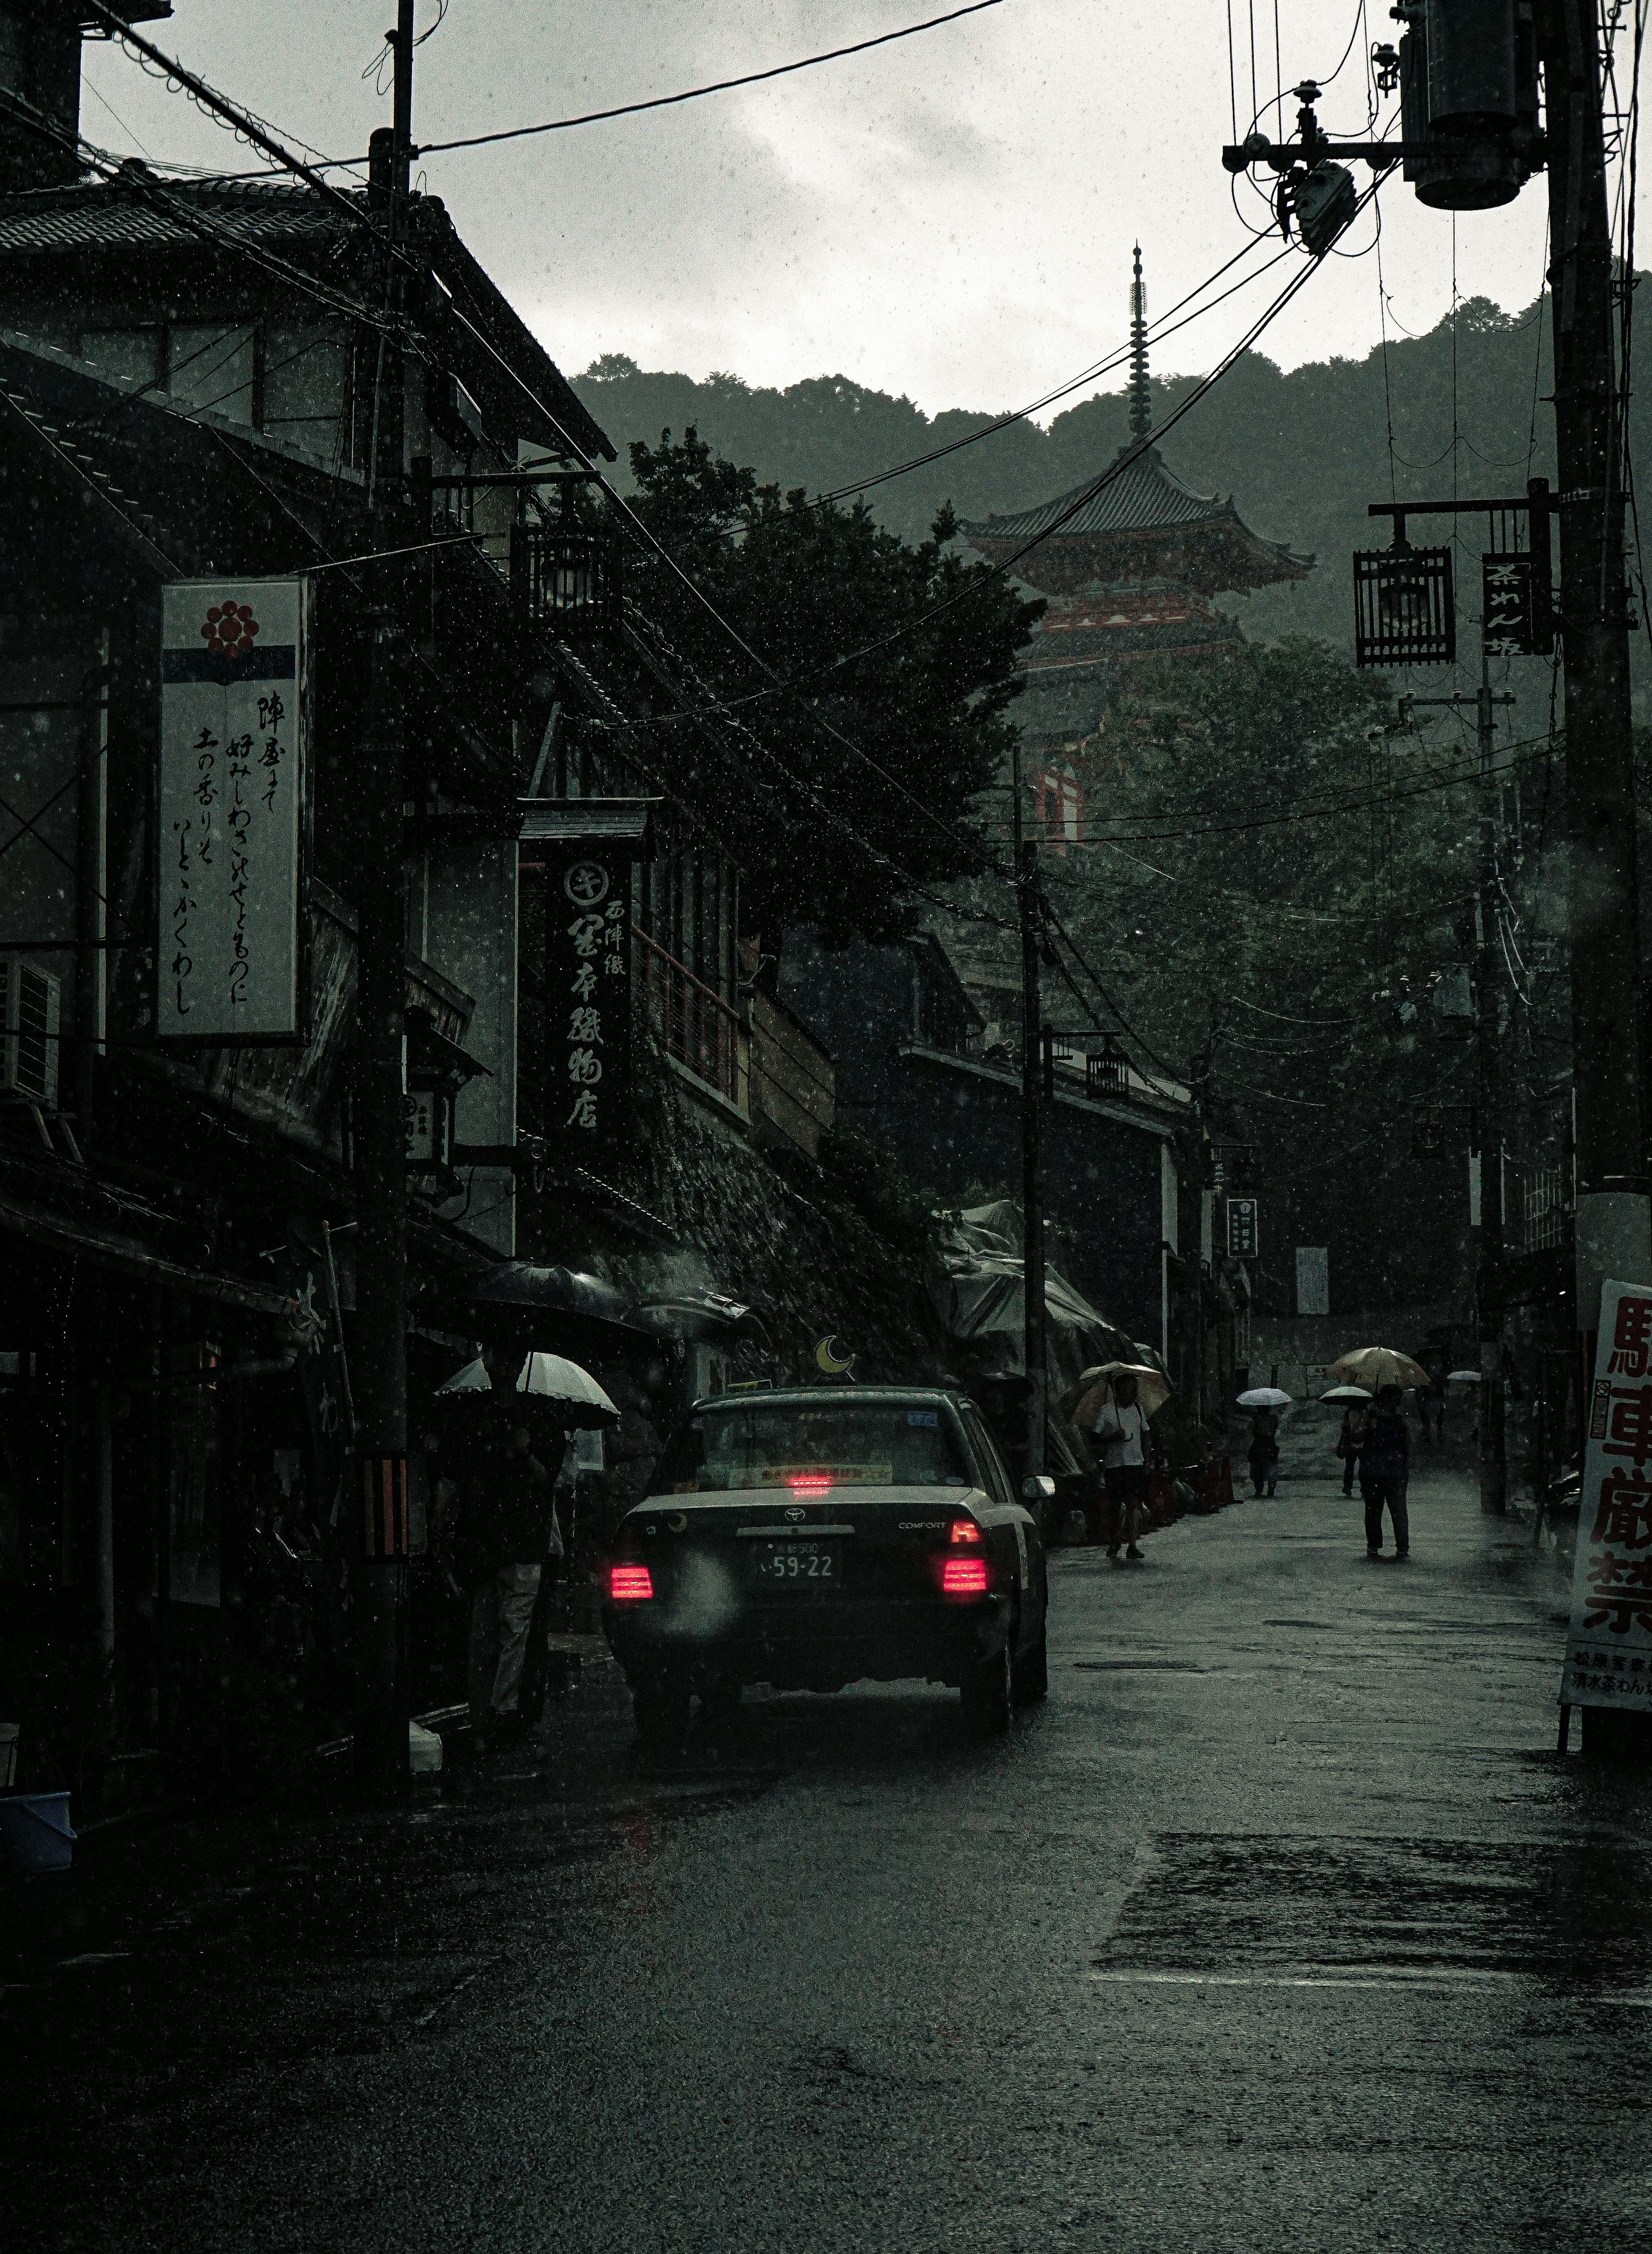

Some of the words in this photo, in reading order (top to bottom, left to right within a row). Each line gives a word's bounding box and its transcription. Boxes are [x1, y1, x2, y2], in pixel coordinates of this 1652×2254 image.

[1484, 563, 1525, 656] 茶わん坂
[604, 899, 626, 975] 西陣織
[773, 1556, 832, 1577] 59-22
[1574, 1652, 1652, 1673] 松原警察
